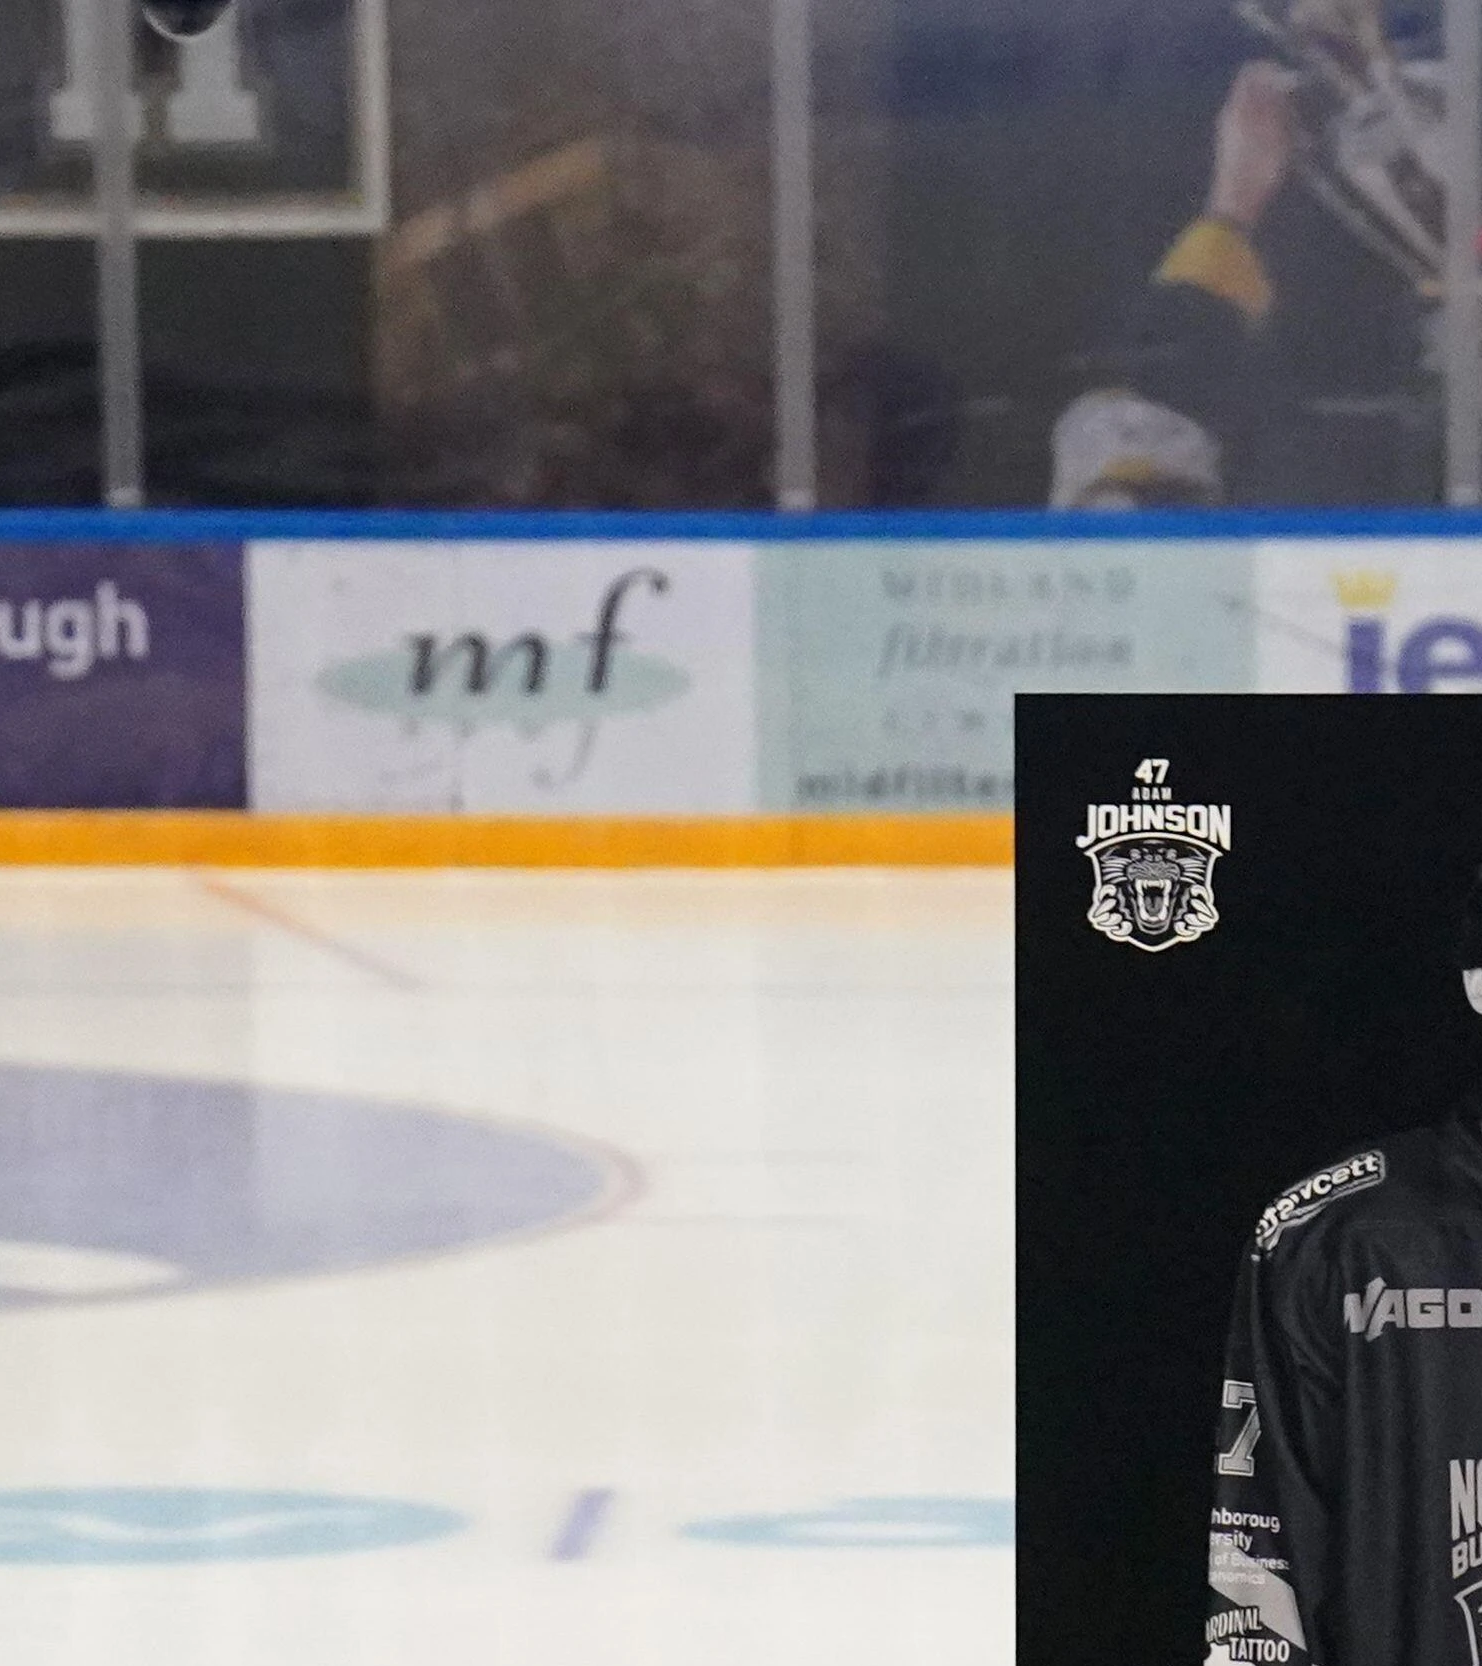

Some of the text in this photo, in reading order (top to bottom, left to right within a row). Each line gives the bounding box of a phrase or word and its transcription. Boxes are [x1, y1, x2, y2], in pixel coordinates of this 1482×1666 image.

[403, 567, 670, 697] mf
[1134, 758, 1171, 784] 47
[1132, 787, 1172, 801] ADAM
[1075, 804, 1232, 851] JOHNSON
[1228, 1637, 1291, 1664] TATTOO
